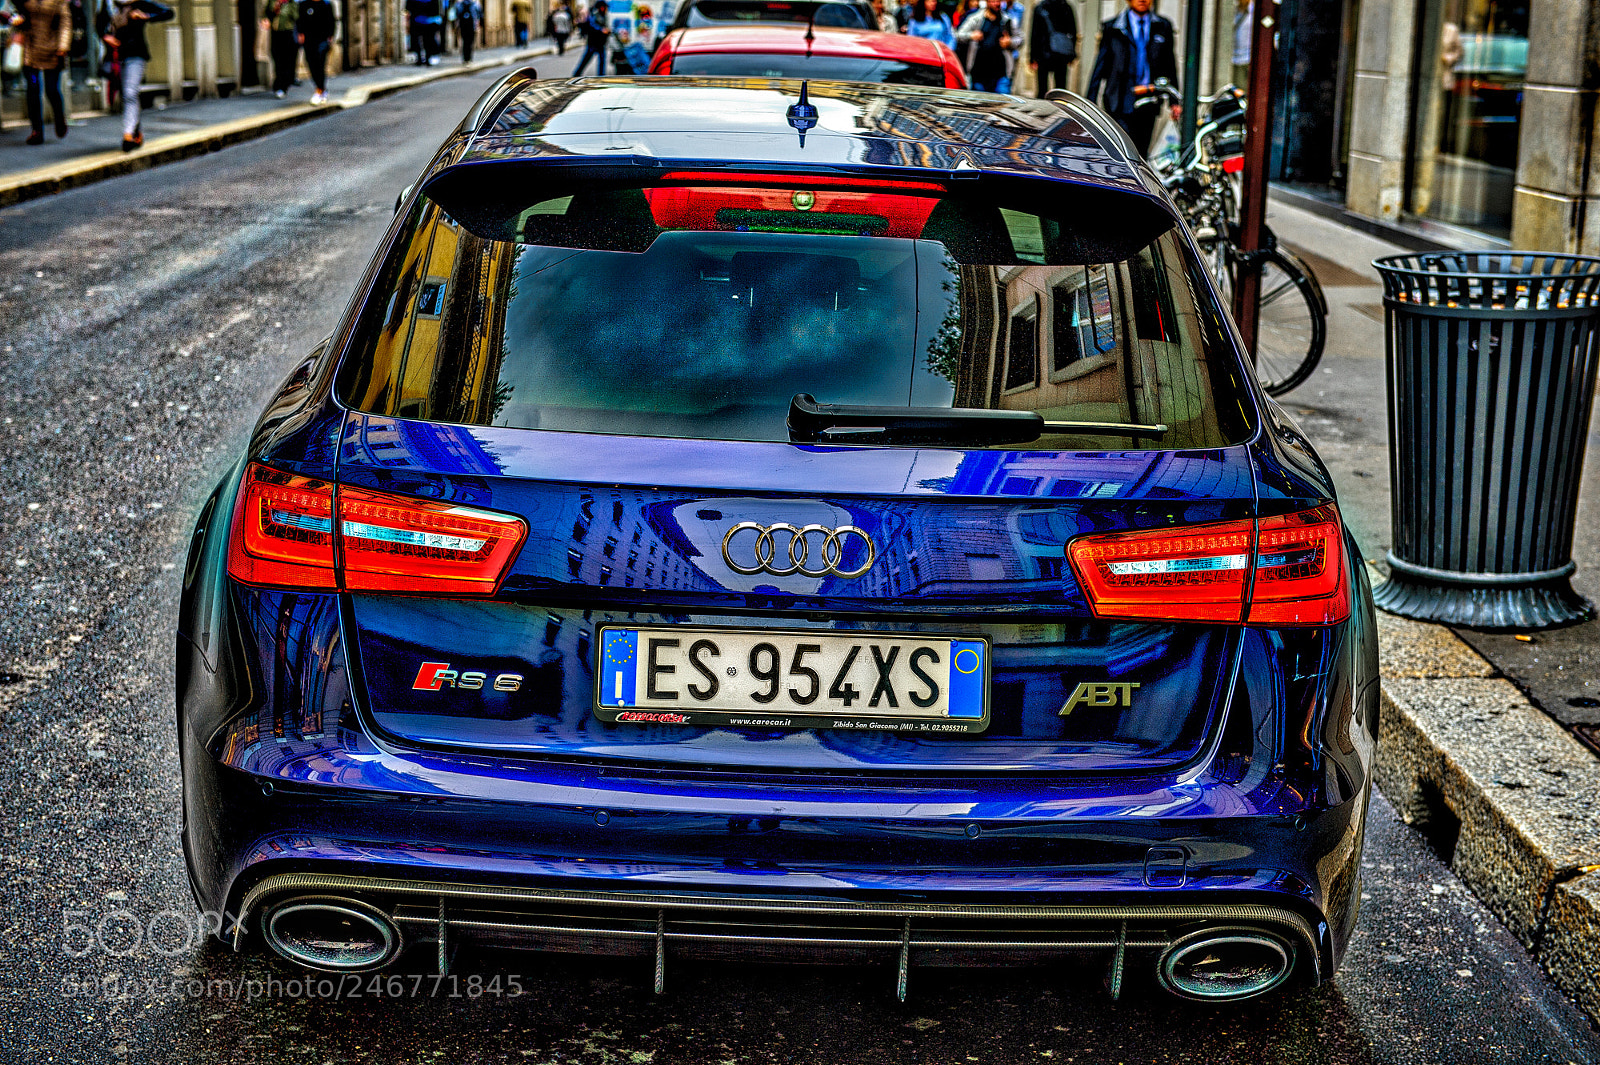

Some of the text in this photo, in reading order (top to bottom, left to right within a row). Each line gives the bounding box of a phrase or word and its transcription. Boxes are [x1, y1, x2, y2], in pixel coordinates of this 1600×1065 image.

[430, 668, 523, 692] RS 6
[647, 637, 941, 708] ES 954XS
[1059, 682, 1141, 716] ABT
[833, 720, 854, 728] Zibido
[855, 721, 868, 729] San
[869, 722, 899, 730] Giacomo
[899, 723, 914, 731] (MI)
[920, 723, 930, 731] Tel.
[931, 724, 968, 732] 02.9055218
